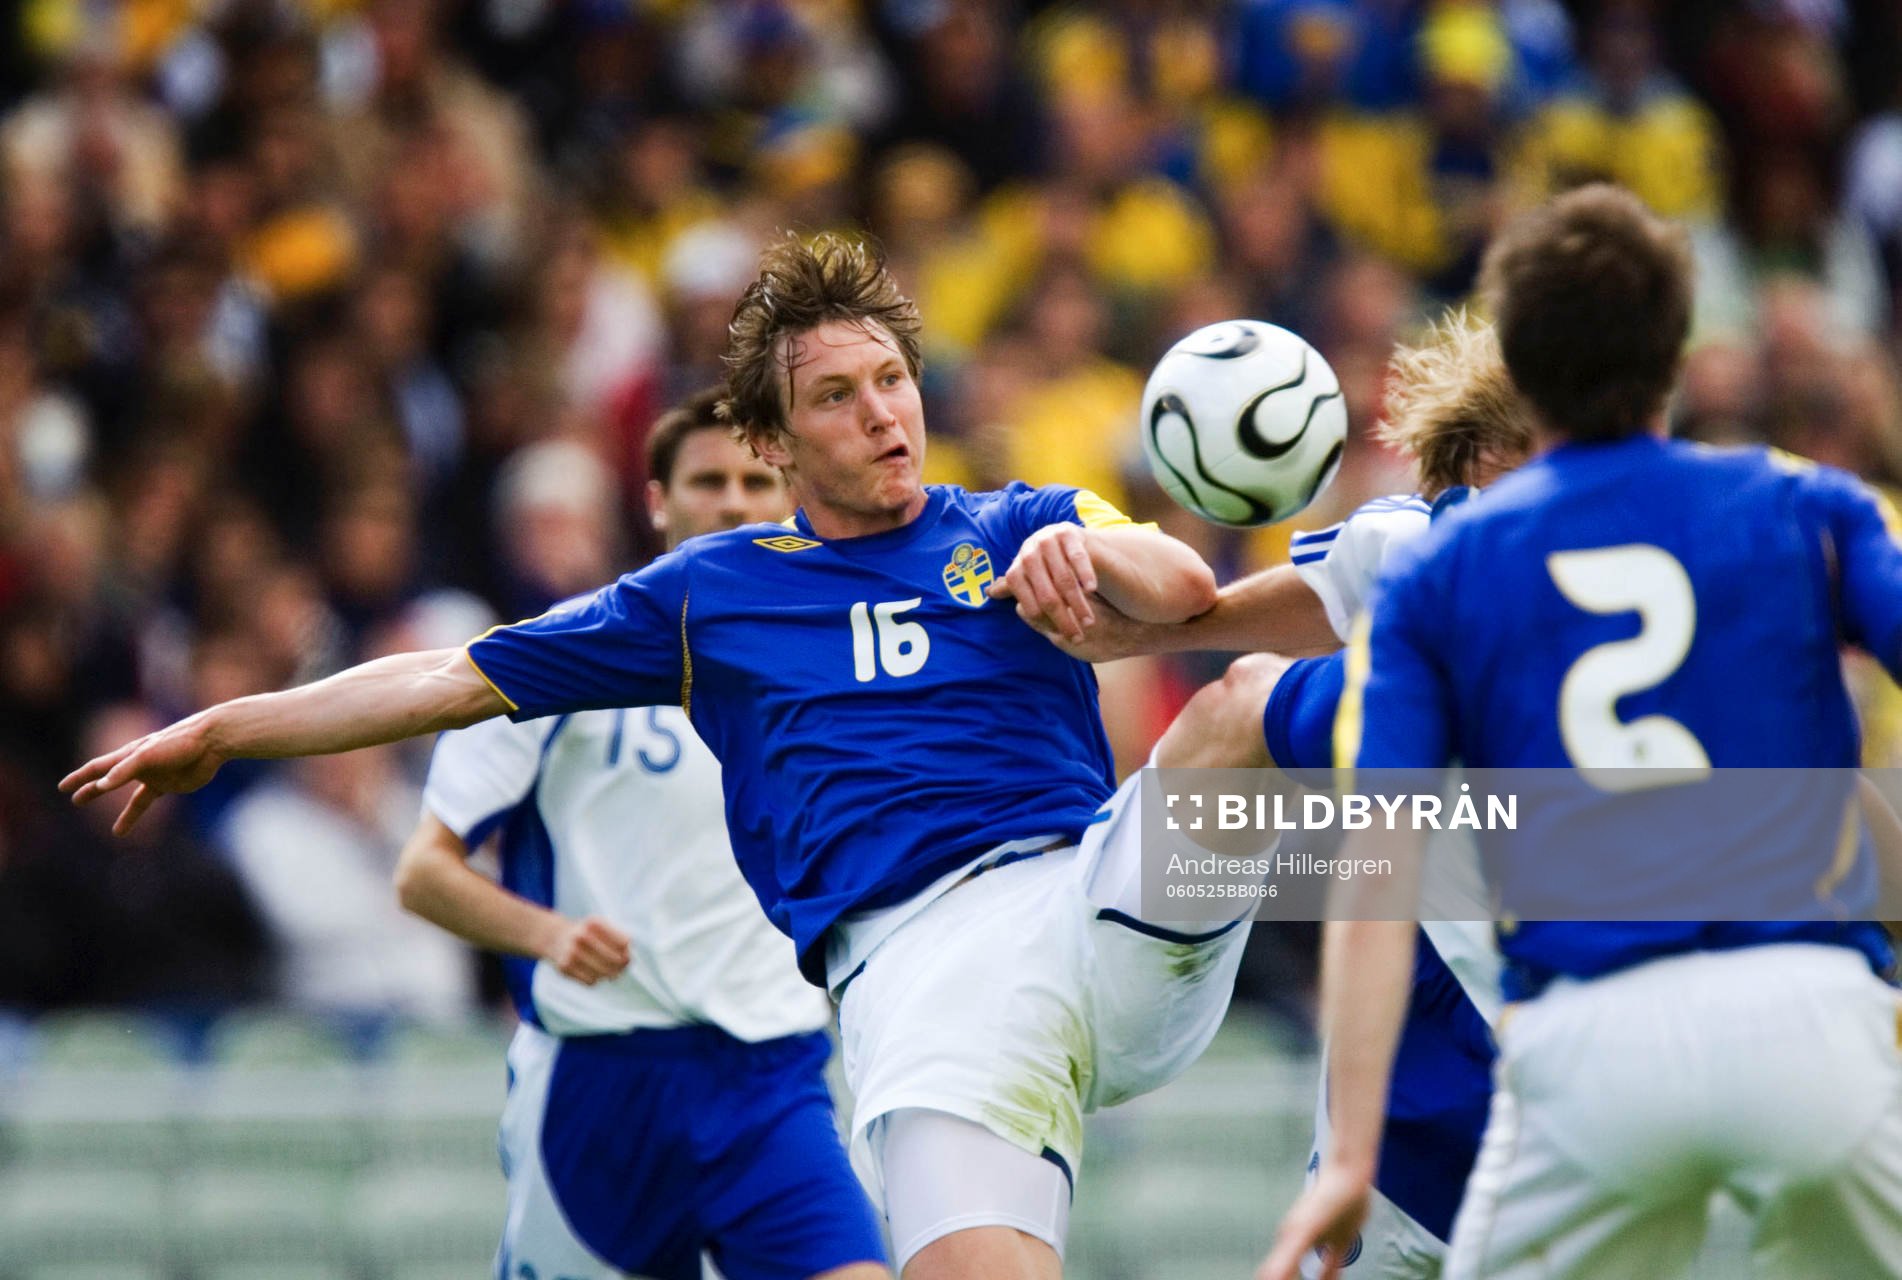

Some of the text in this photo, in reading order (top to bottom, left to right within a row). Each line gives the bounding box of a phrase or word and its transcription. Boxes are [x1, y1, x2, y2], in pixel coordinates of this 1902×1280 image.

[850, 597, 930, 682] 16
[1545, 543, 1712, 792] 2
[607, 706, 681, 773] 15
